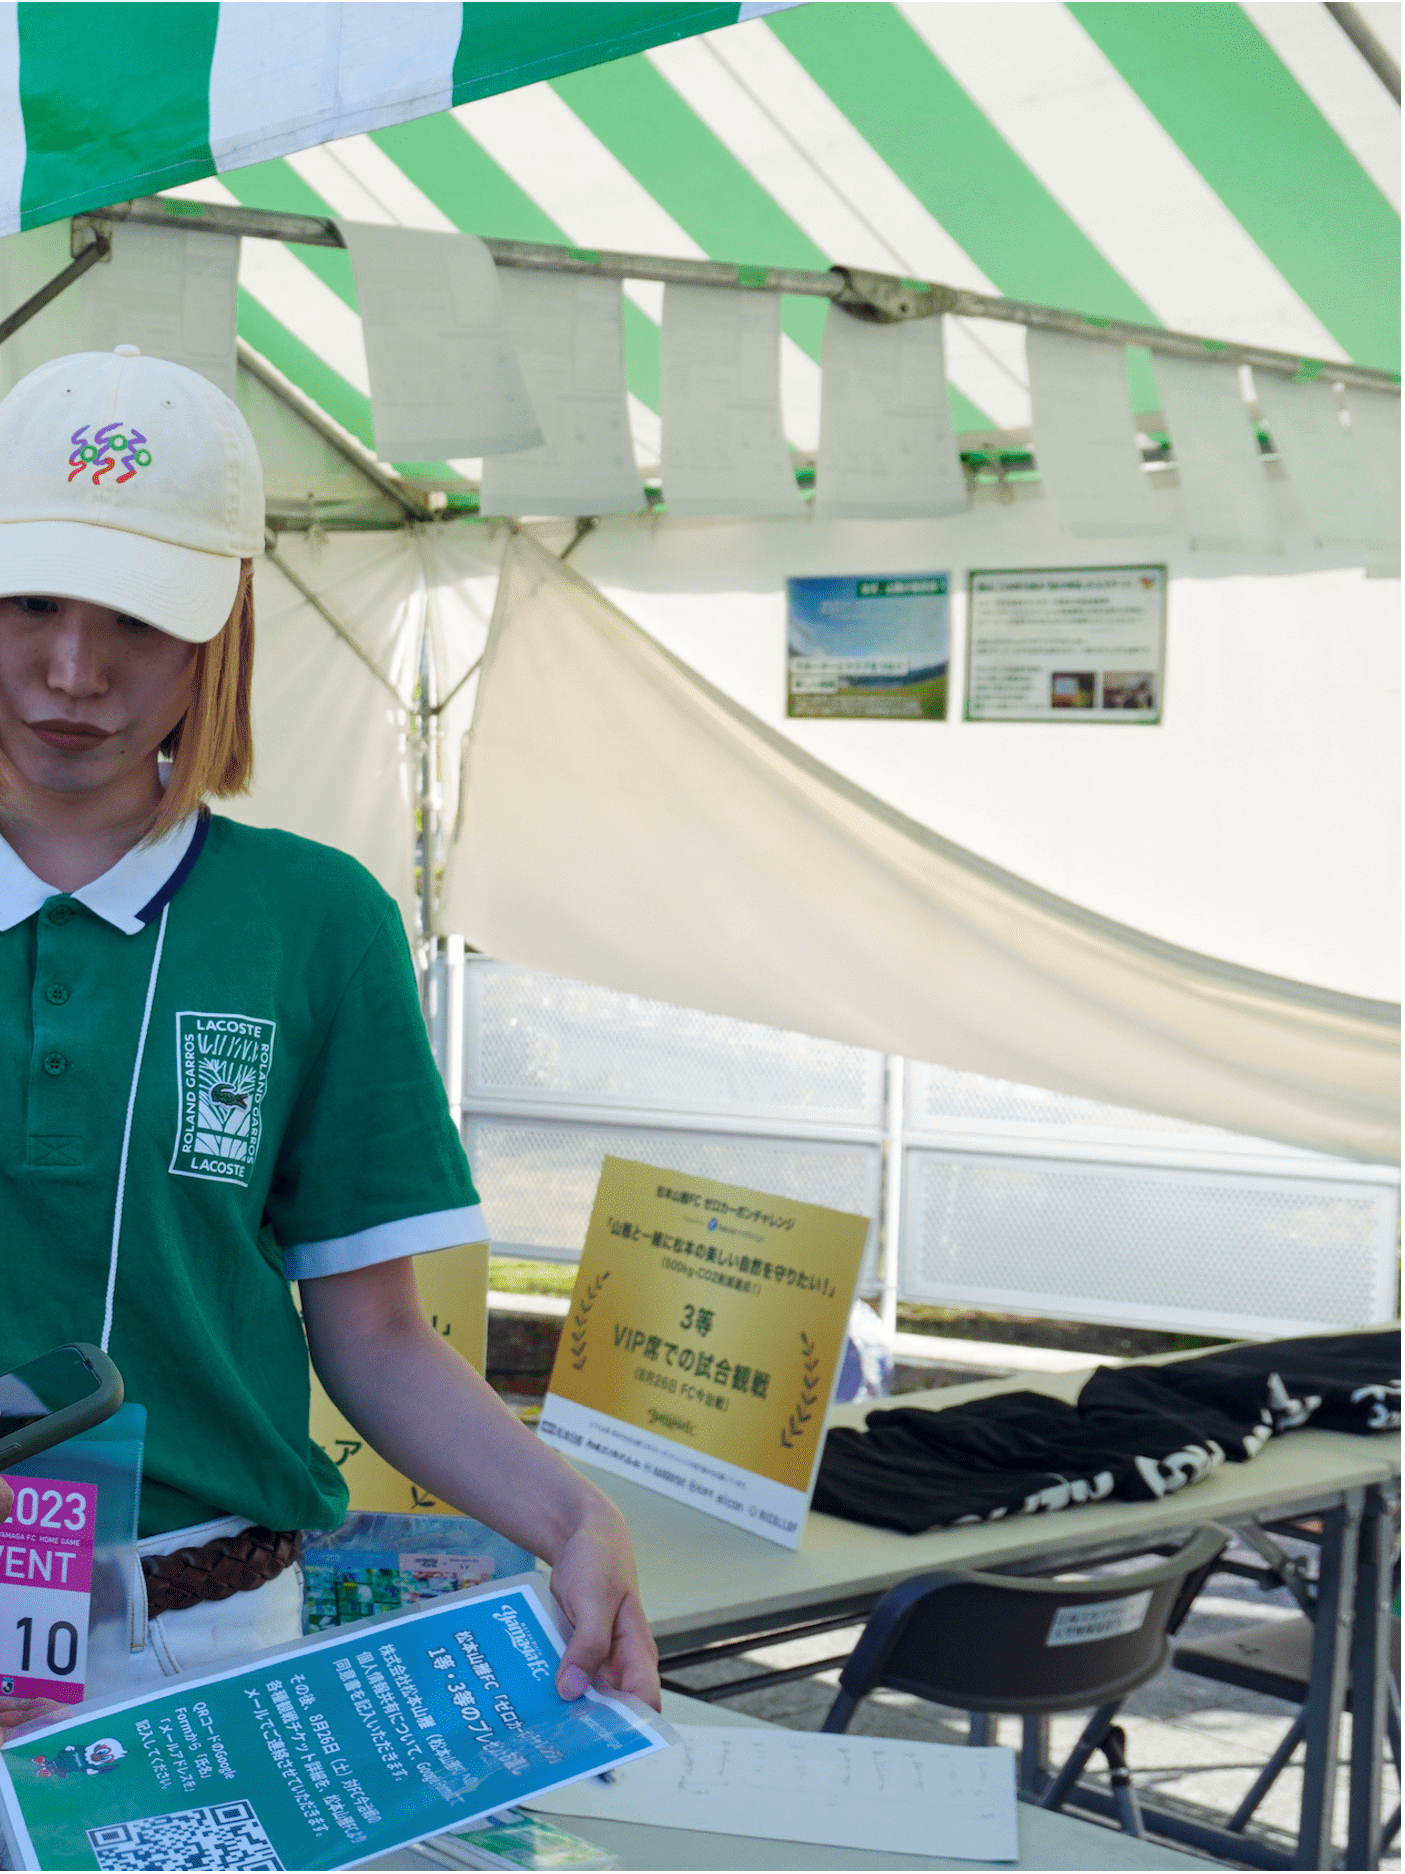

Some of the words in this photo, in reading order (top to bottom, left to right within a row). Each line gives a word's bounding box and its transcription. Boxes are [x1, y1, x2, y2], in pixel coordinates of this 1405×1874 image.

[196, 1019, 262, 1038] LACOSTE
[184, 1033, 196, 1088] GARROS
[255, 1043, 269, 1104] ROLAND
[182, 1090, 196, 1153] ROLAND
[246, 1106, 260, 1164] GARROS
[191, 1157, 246, 1178] LACOSTE
[678, 1302, 715, 1339] 3等
[611, 1321, 772, 1401] VIP席での試合観戦
[3, 1487, 87, 1531] 023
[39, 1535, 59, 1545] HOME
[60, 1537, 81, 1547] GAME
[331, 1657, 408, 1780] 同意書を記入いただきます。
[135, 1719, 172, 1789] 記入してください。
[242, 1687, 329, 1836] メールでご連絡させていただきます。
